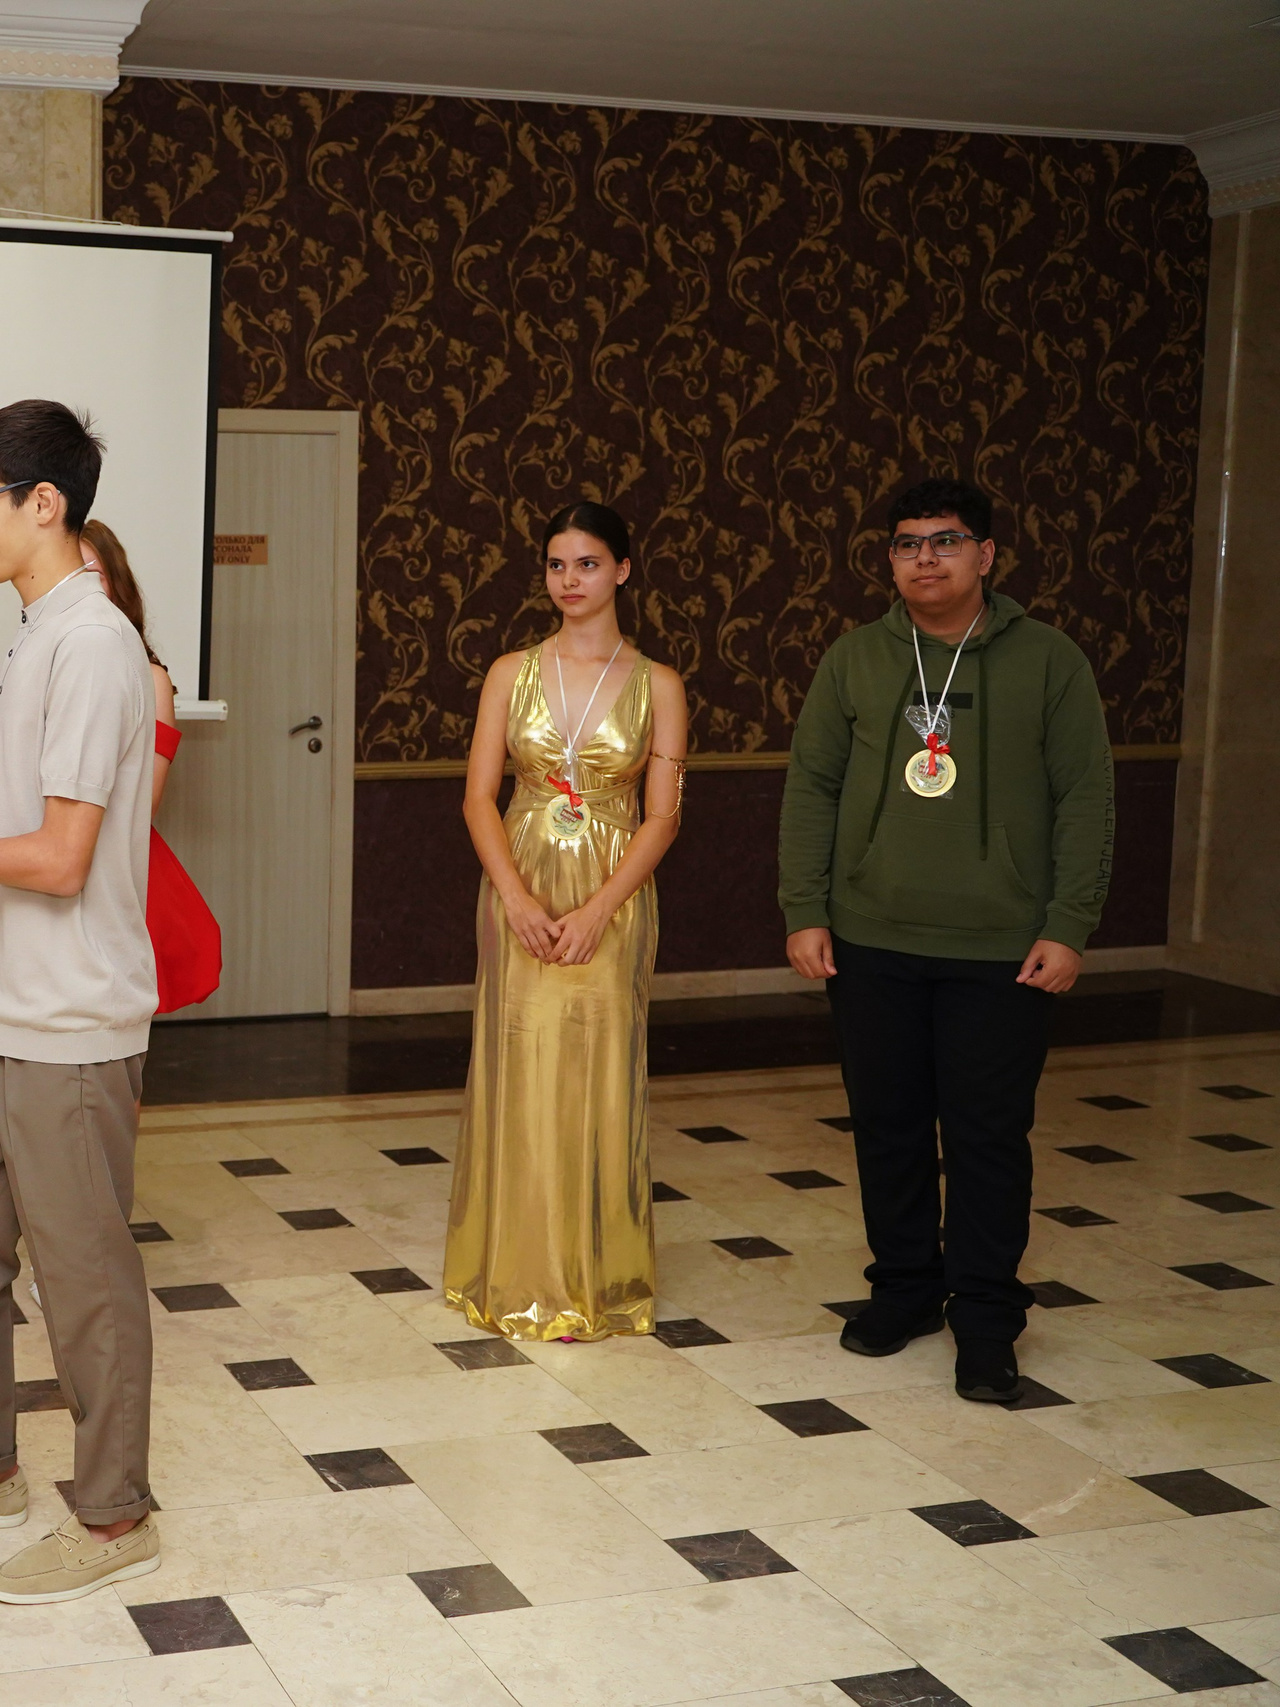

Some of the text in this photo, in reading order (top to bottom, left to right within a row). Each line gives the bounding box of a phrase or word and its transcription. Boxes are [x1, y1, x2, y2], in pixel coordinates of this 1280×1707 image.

[246, 535, 265, 545] ДЛЯ
[227, 555, 250, 564] ONLY
[1093, 849, 1112, 901] JEANS
